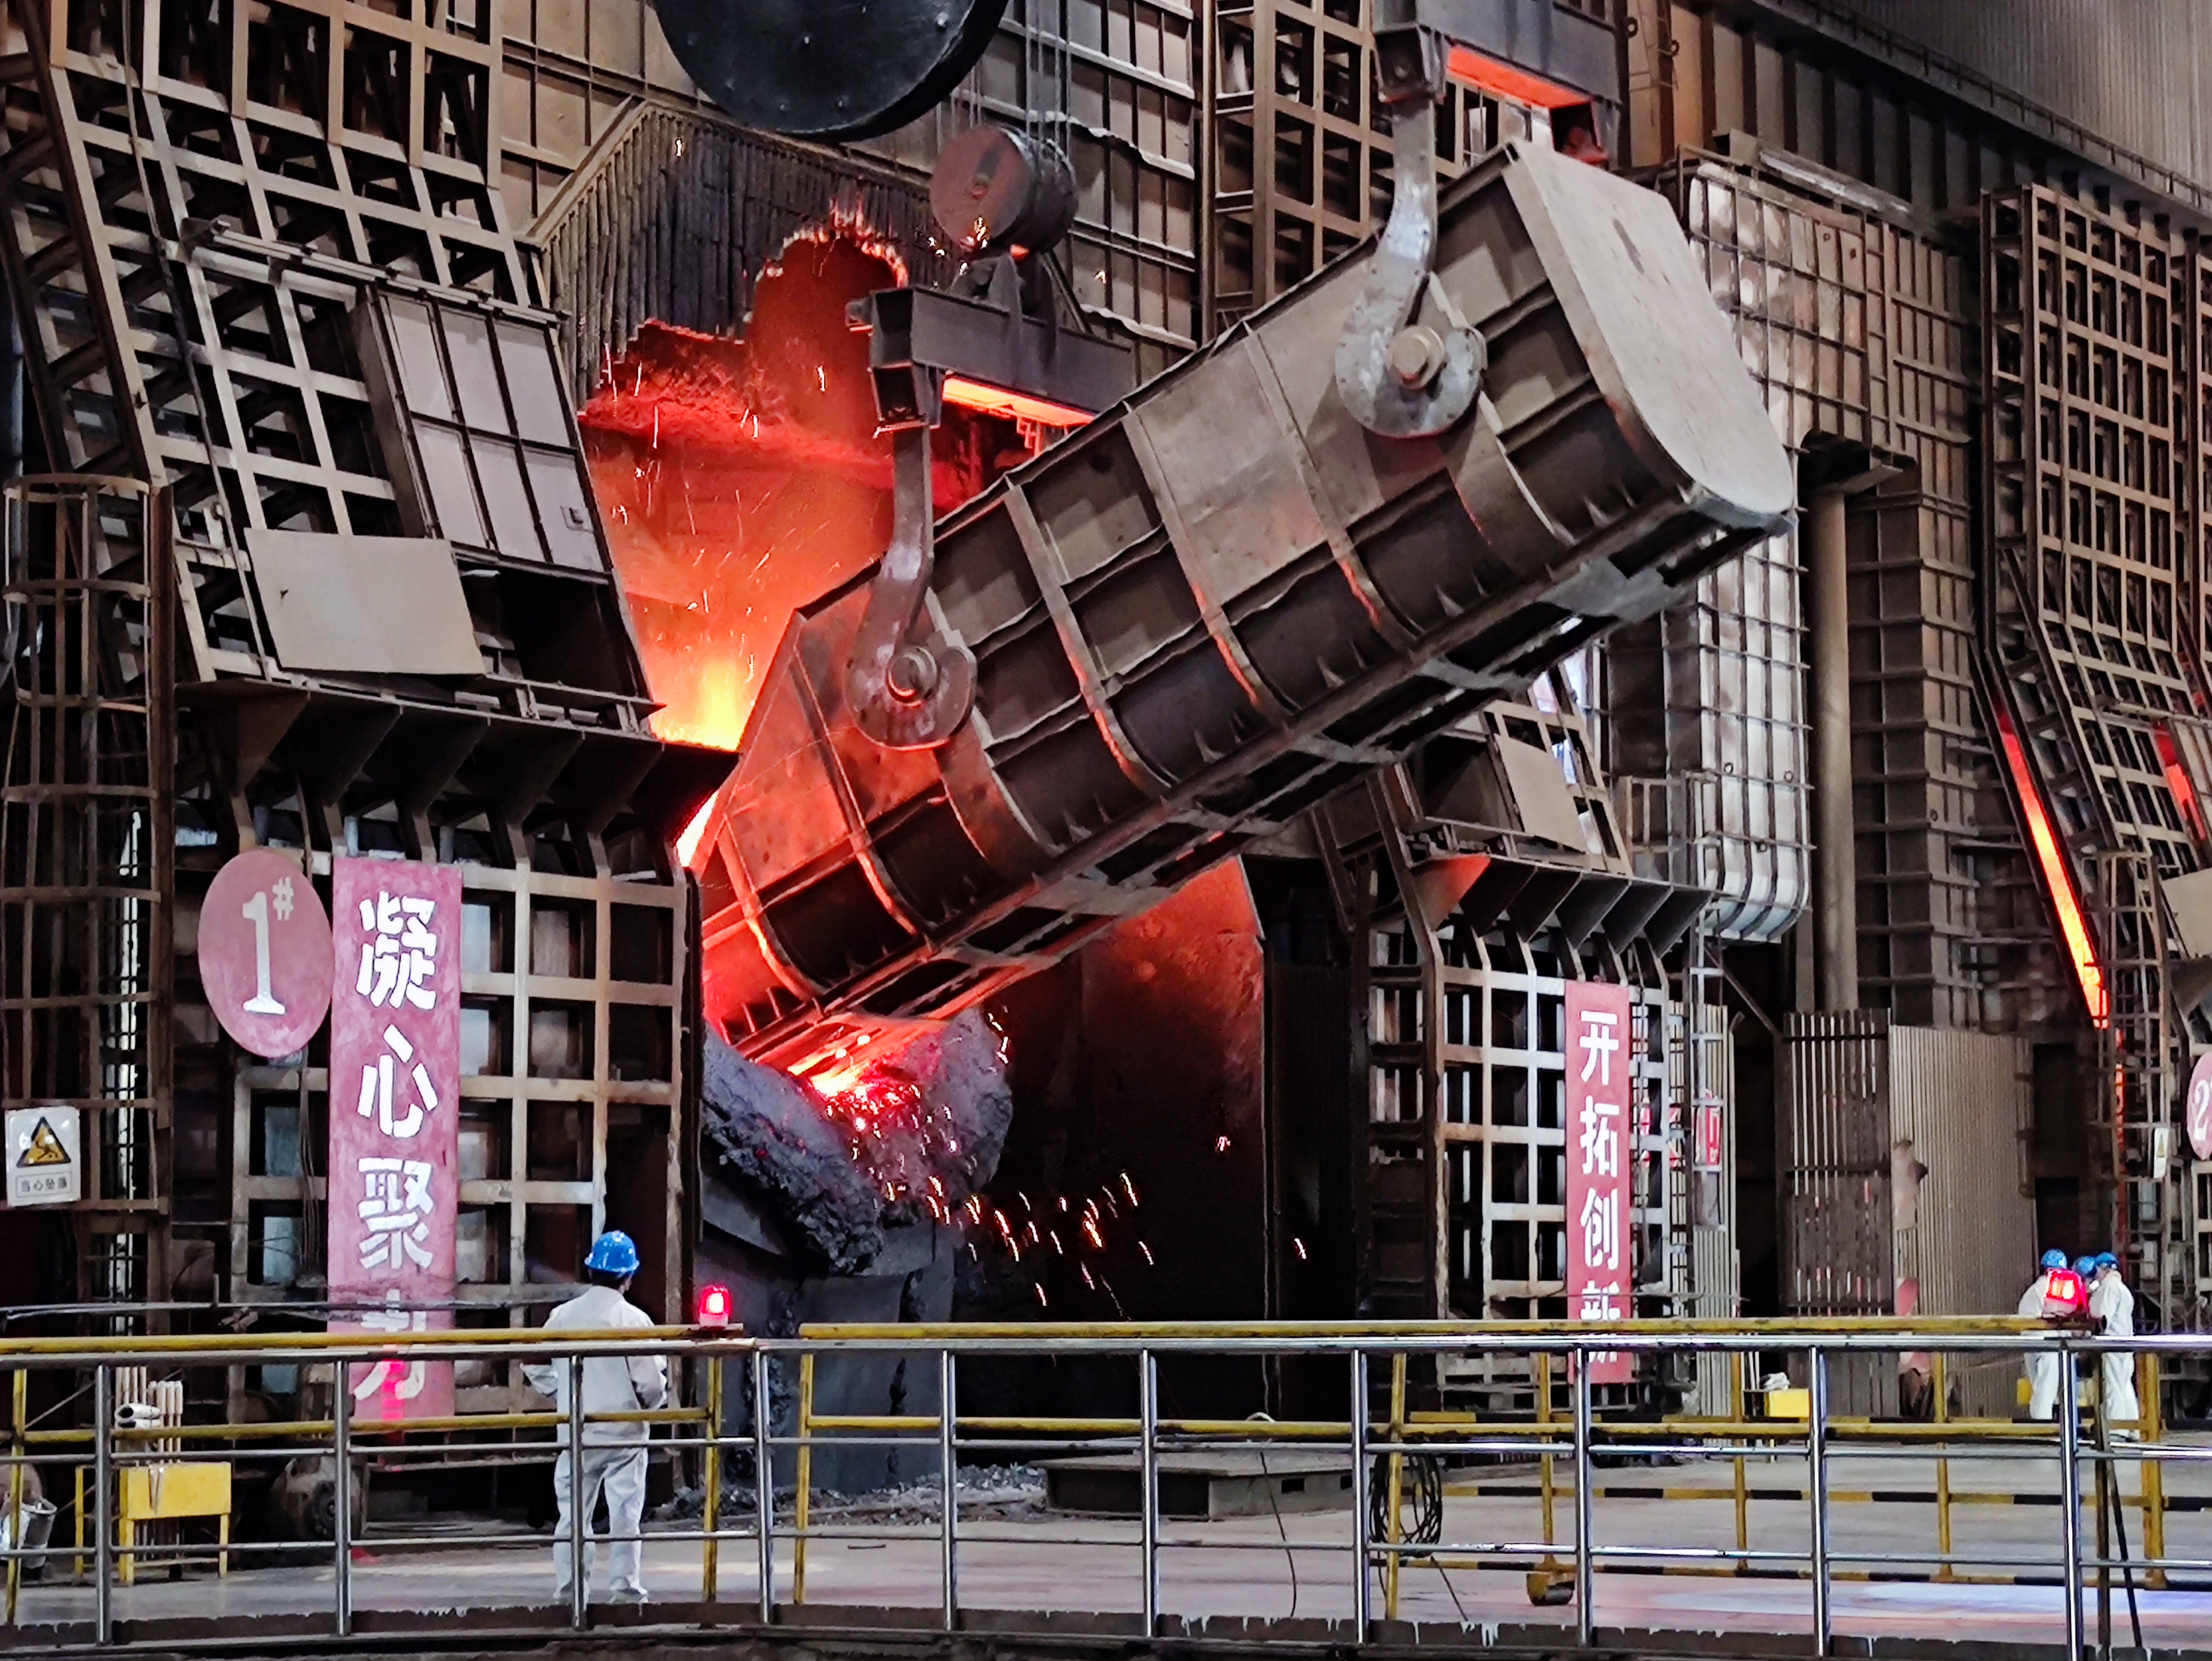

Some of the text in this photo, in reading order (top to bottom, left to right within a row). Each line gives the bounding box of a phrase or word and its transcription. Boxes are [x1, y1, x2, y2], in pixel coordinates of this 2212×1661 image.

[354, 889, 438, 1400] 凝心聚力
[1579, 1010, 1621, 1363] 开拓创新
[2194, 1079, 2212, 1141] 2
